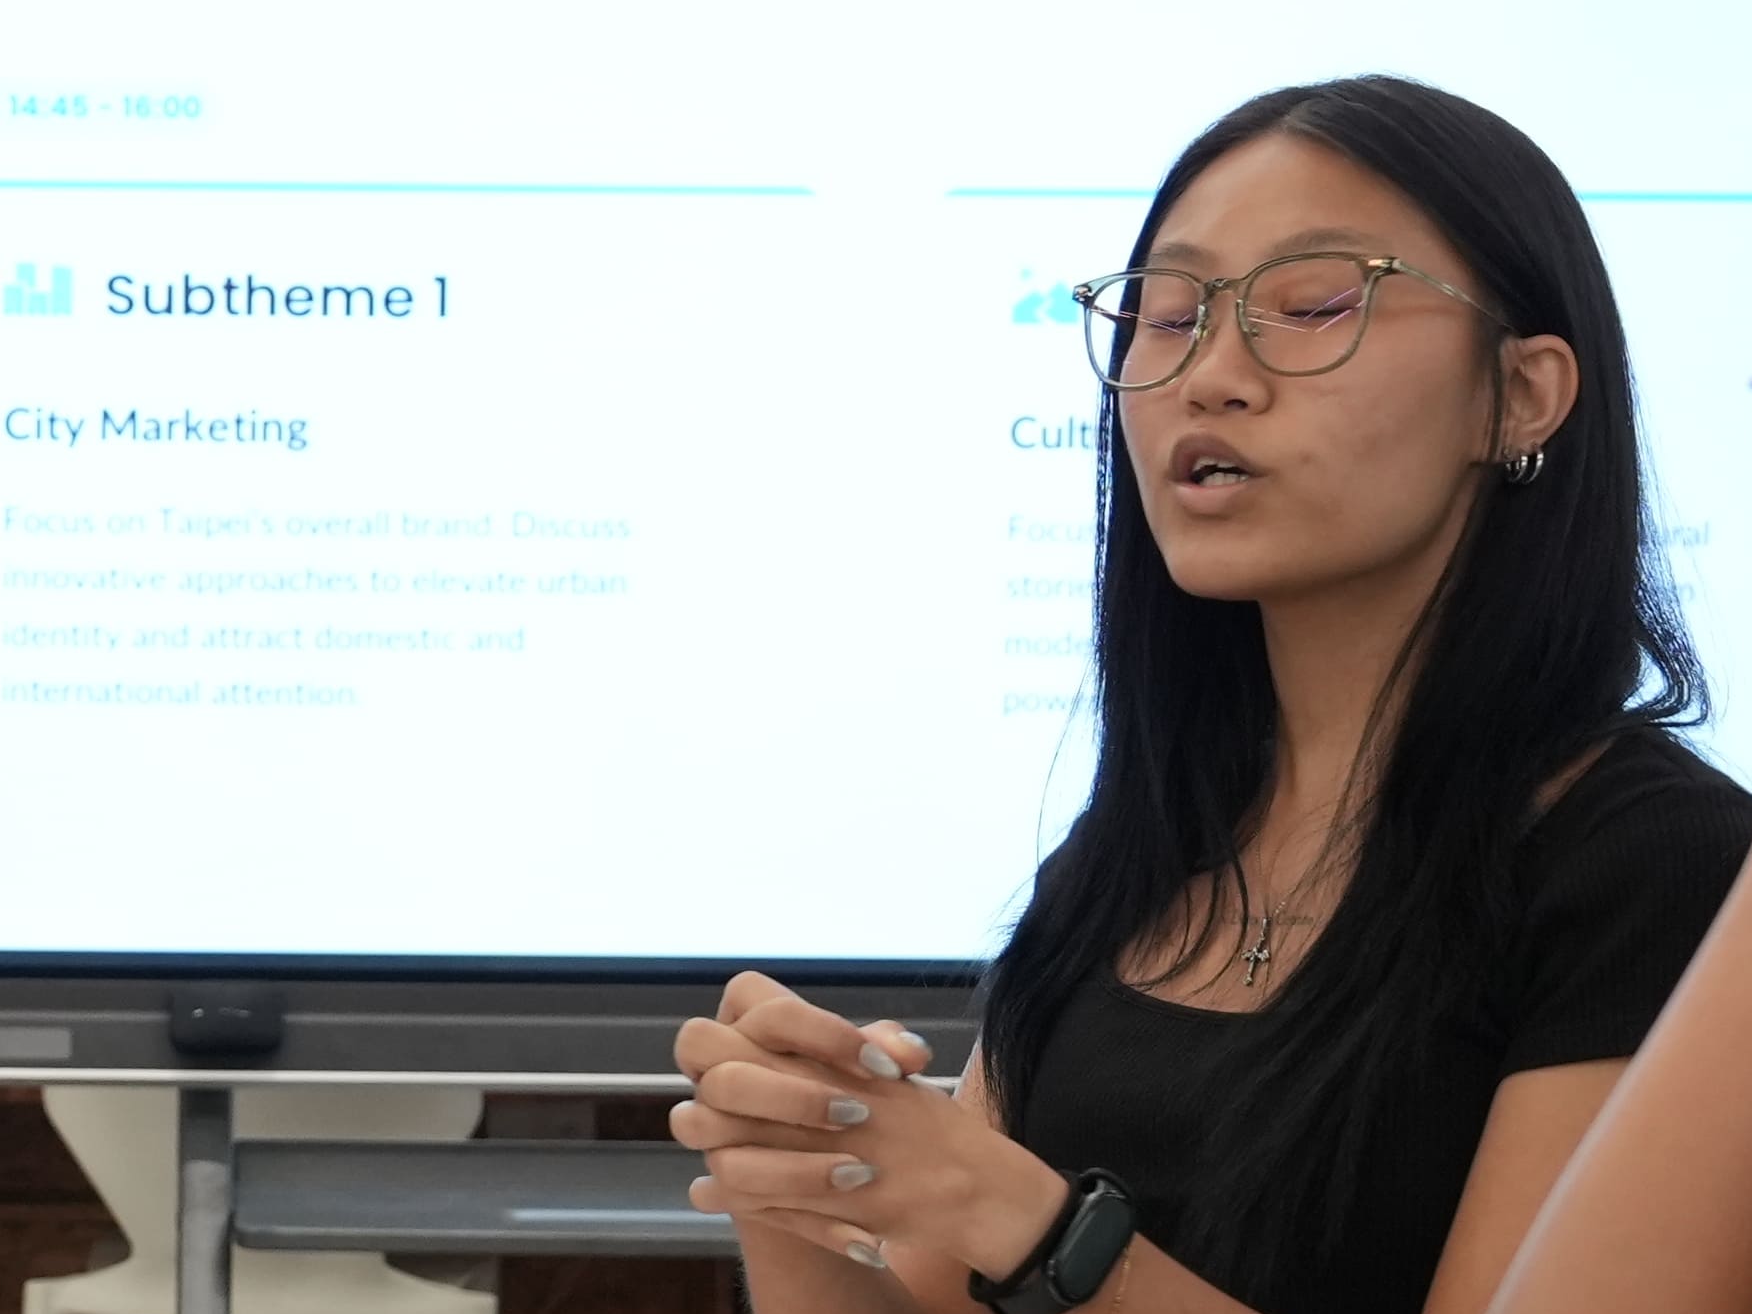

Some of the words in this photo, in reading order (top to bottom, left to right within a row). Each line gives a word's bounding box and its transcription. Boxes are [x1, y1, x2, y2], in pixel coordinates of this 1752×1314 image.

[6, 91, 91, 120] 14:45
[120, 93, 204, 121] 16:00
[106, 272, 415, 319] Subtheme
[433, 275, 449, 318] 1
[3, 406, 86, 448] City
[100, 407, 309, 452] Marketing
[1009, 412, 1096, 451] Cult
[1, 502, 99, 537] Focus
[105, 512, 149, 537] on
[157, 505, 278, 542] Taipei's
[283, 509, 393, 540] overall
[511, 509, 633, 541] Discuss
[2, 564, 168, 592] innovative
[176, 565, 361, 602] approaches
[368, 567, 403, 595] to
[410, 568, 529, 596] elevate
[535, 568, 630, 597] urban
[1006, 574, 1092, 600] storie
[0, 620, 125, 655] identity
[130, 622, 190, 652] and
[199, 623, 305, 653] attract
[313, 623, 453, 653] domestic
[466, 624, 528, 654] and
[1003, 630, 1091, 657] mode
[0, 678, 203, 707] international
